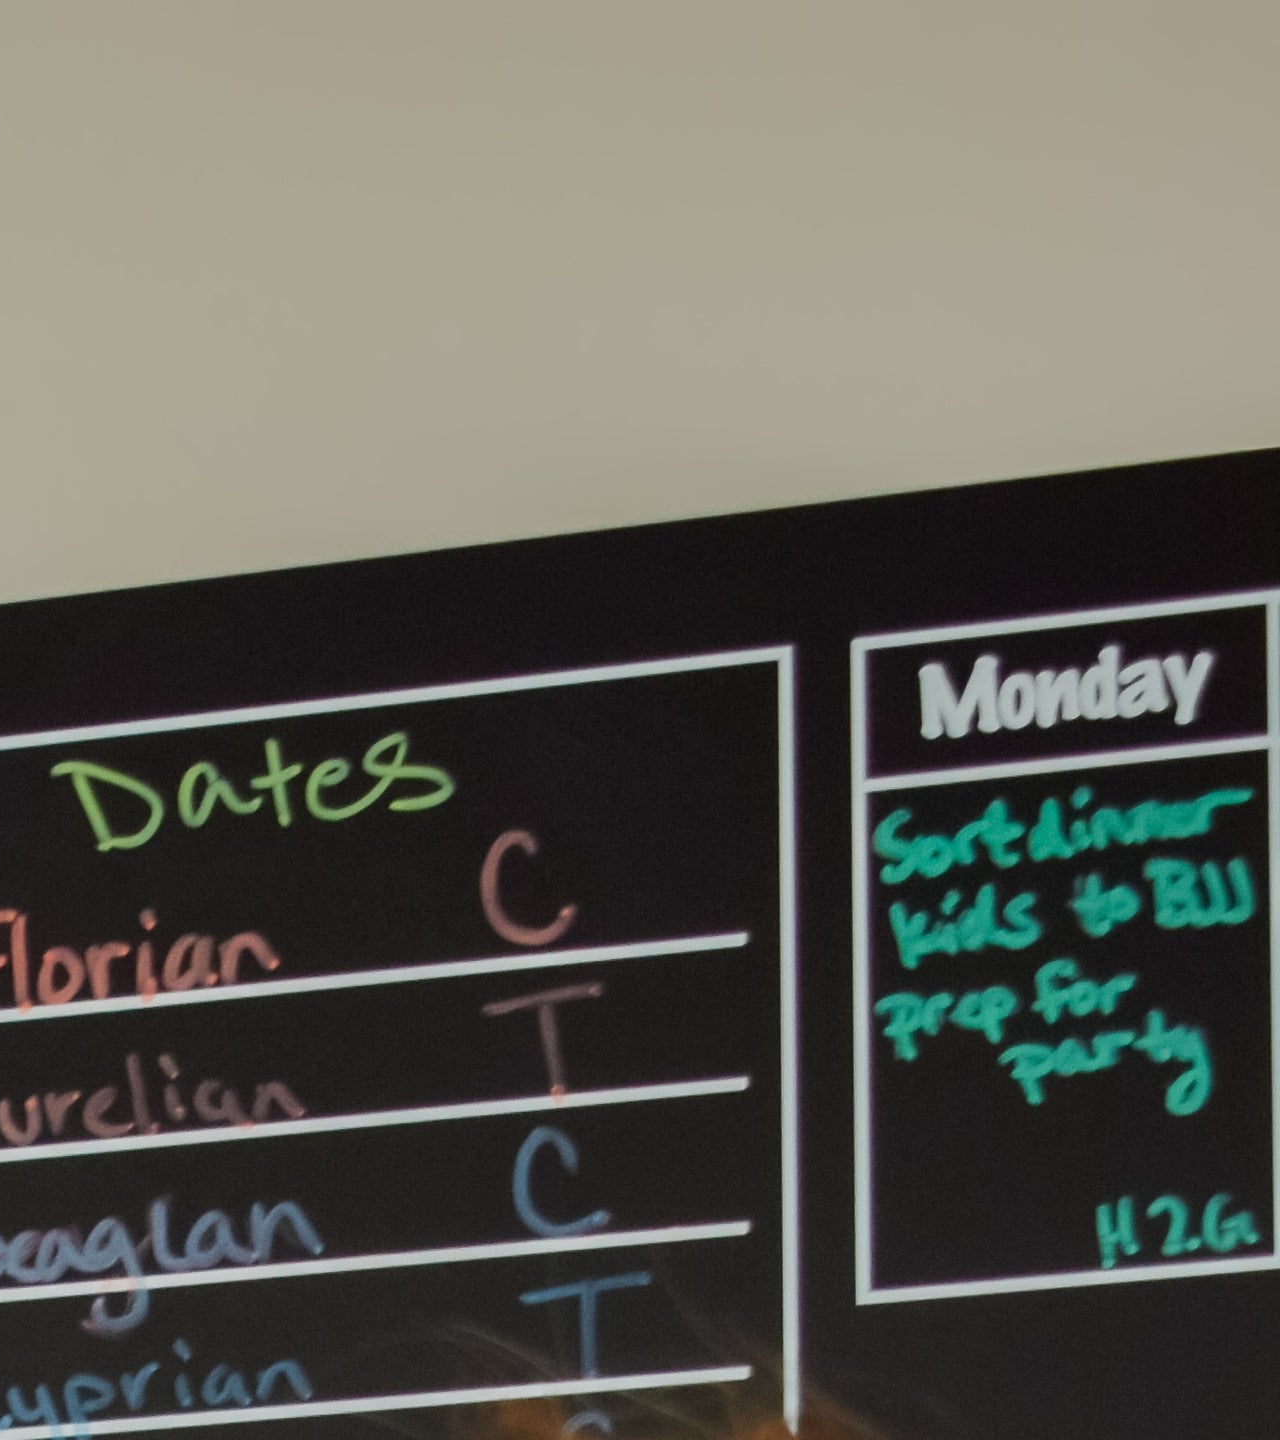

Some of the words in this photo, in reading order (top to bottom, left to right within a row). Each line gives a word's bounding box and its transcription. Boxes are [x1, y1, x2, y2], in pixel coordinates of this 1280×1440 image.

[917, 644, 1216, 741] Monday
[51, 731, 454, 851] Dates
[872, 799, 1024, 885] Sort
[479, 829, 577, 947] C
[888, 883, 1041, 970] kids
[1068, 871, 1141, 938] to
[481, 982, 603, 1102] T
[875, 985, 1019, 1062] prep
[1032, 957, 1137, 1025] for
[998, 1007, 1213, 1117] party
[512, 1126, 611, 1239] C
[520, 1271, 652, 1380] T
